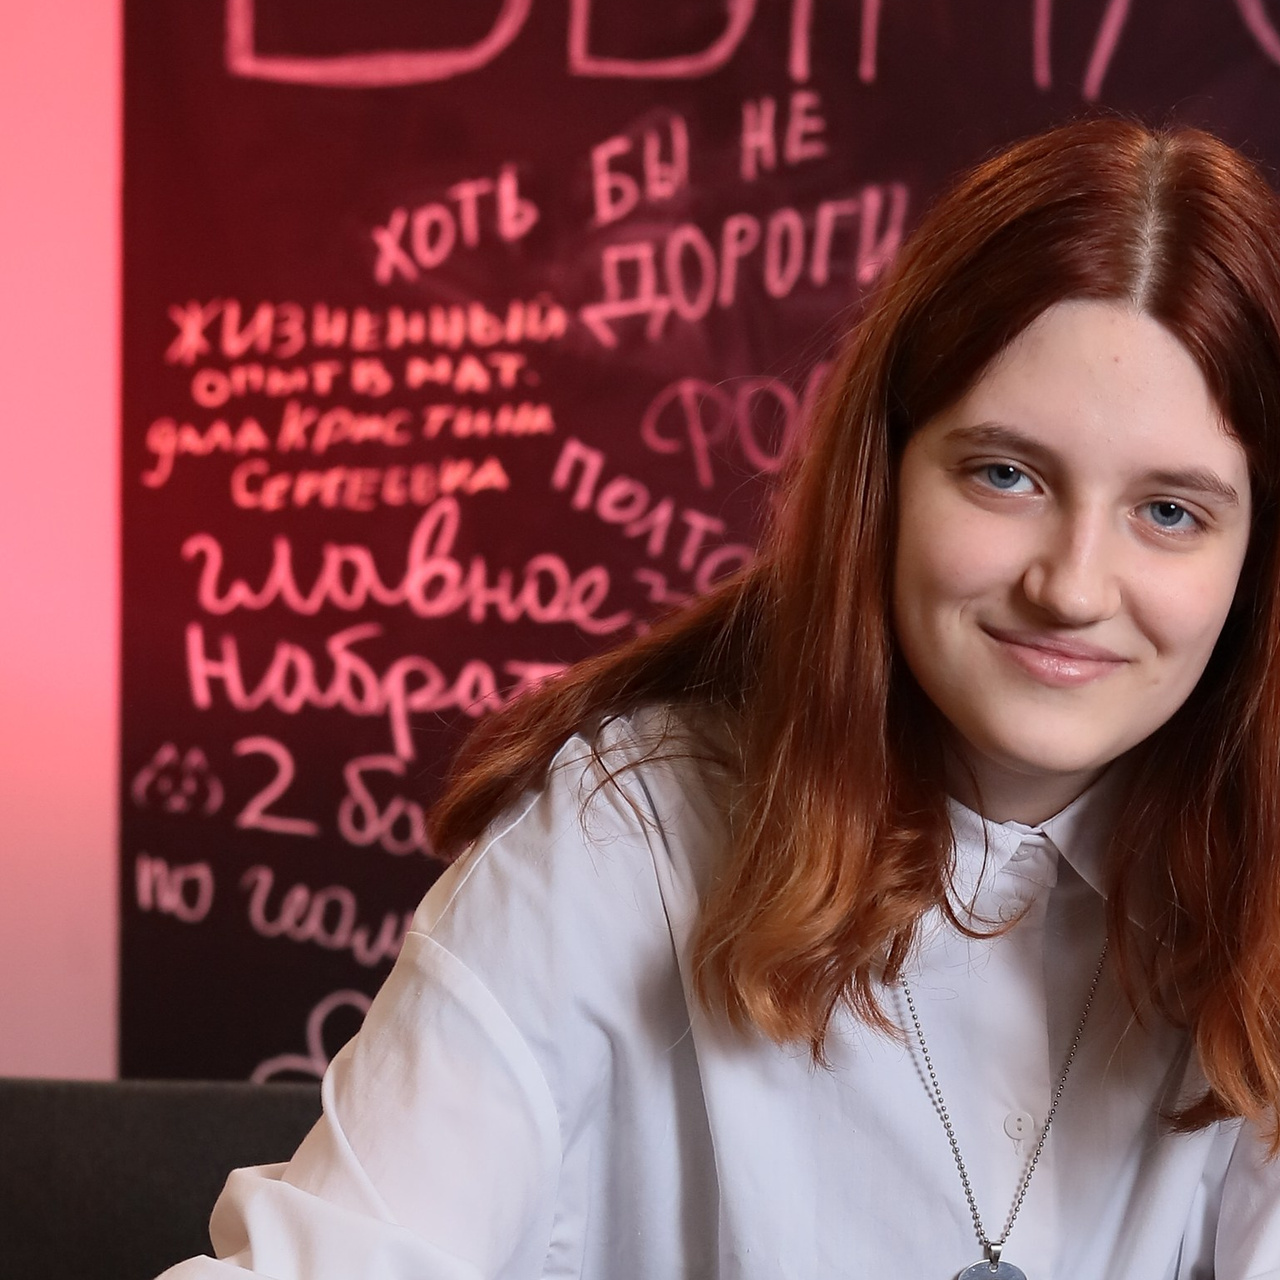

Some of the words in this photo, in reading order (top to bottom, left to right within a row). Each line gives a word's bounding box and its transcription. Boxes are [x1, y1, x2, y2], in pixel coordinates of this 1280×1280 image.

[591, 114, 690, 226] БЫ
[742, 92, 829, 182] НЕ
[164, 295, 569, 367] ЖИЗНЕННЫЙ
[186, 623, 572, 761] набрат
[233, 736, 319, 837] 2
[336, 751, 434, 858] ба
